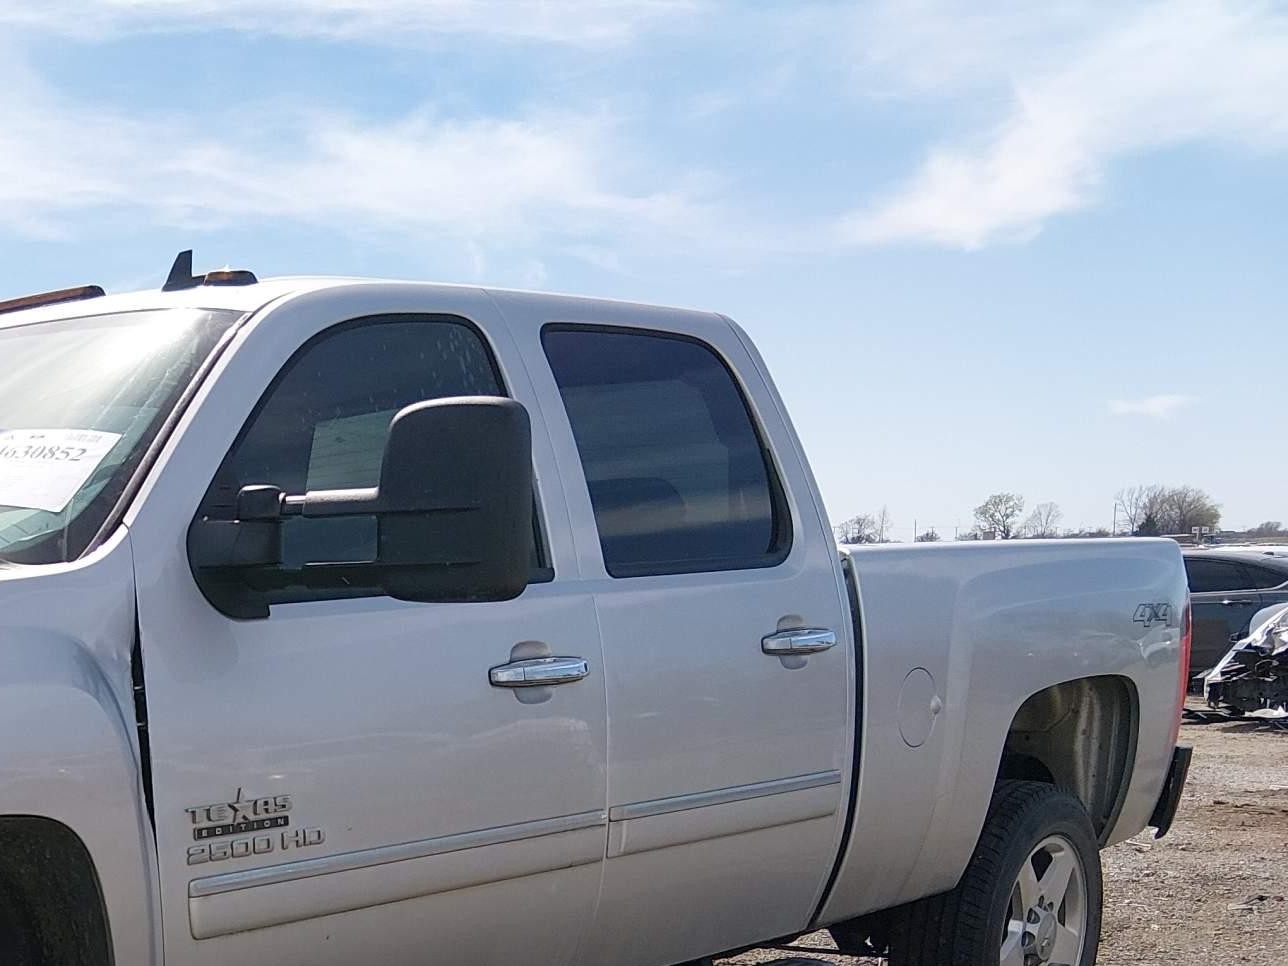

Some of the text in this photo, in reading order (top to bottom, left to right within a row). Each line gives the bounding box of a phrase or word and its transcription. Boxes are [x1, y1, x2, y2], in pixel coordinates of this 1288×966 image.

[184, 788, 294, 824] TEXAS
[200, 818, 286, 837] EDITION
[186, 826, 326, 866] 2500 HD
